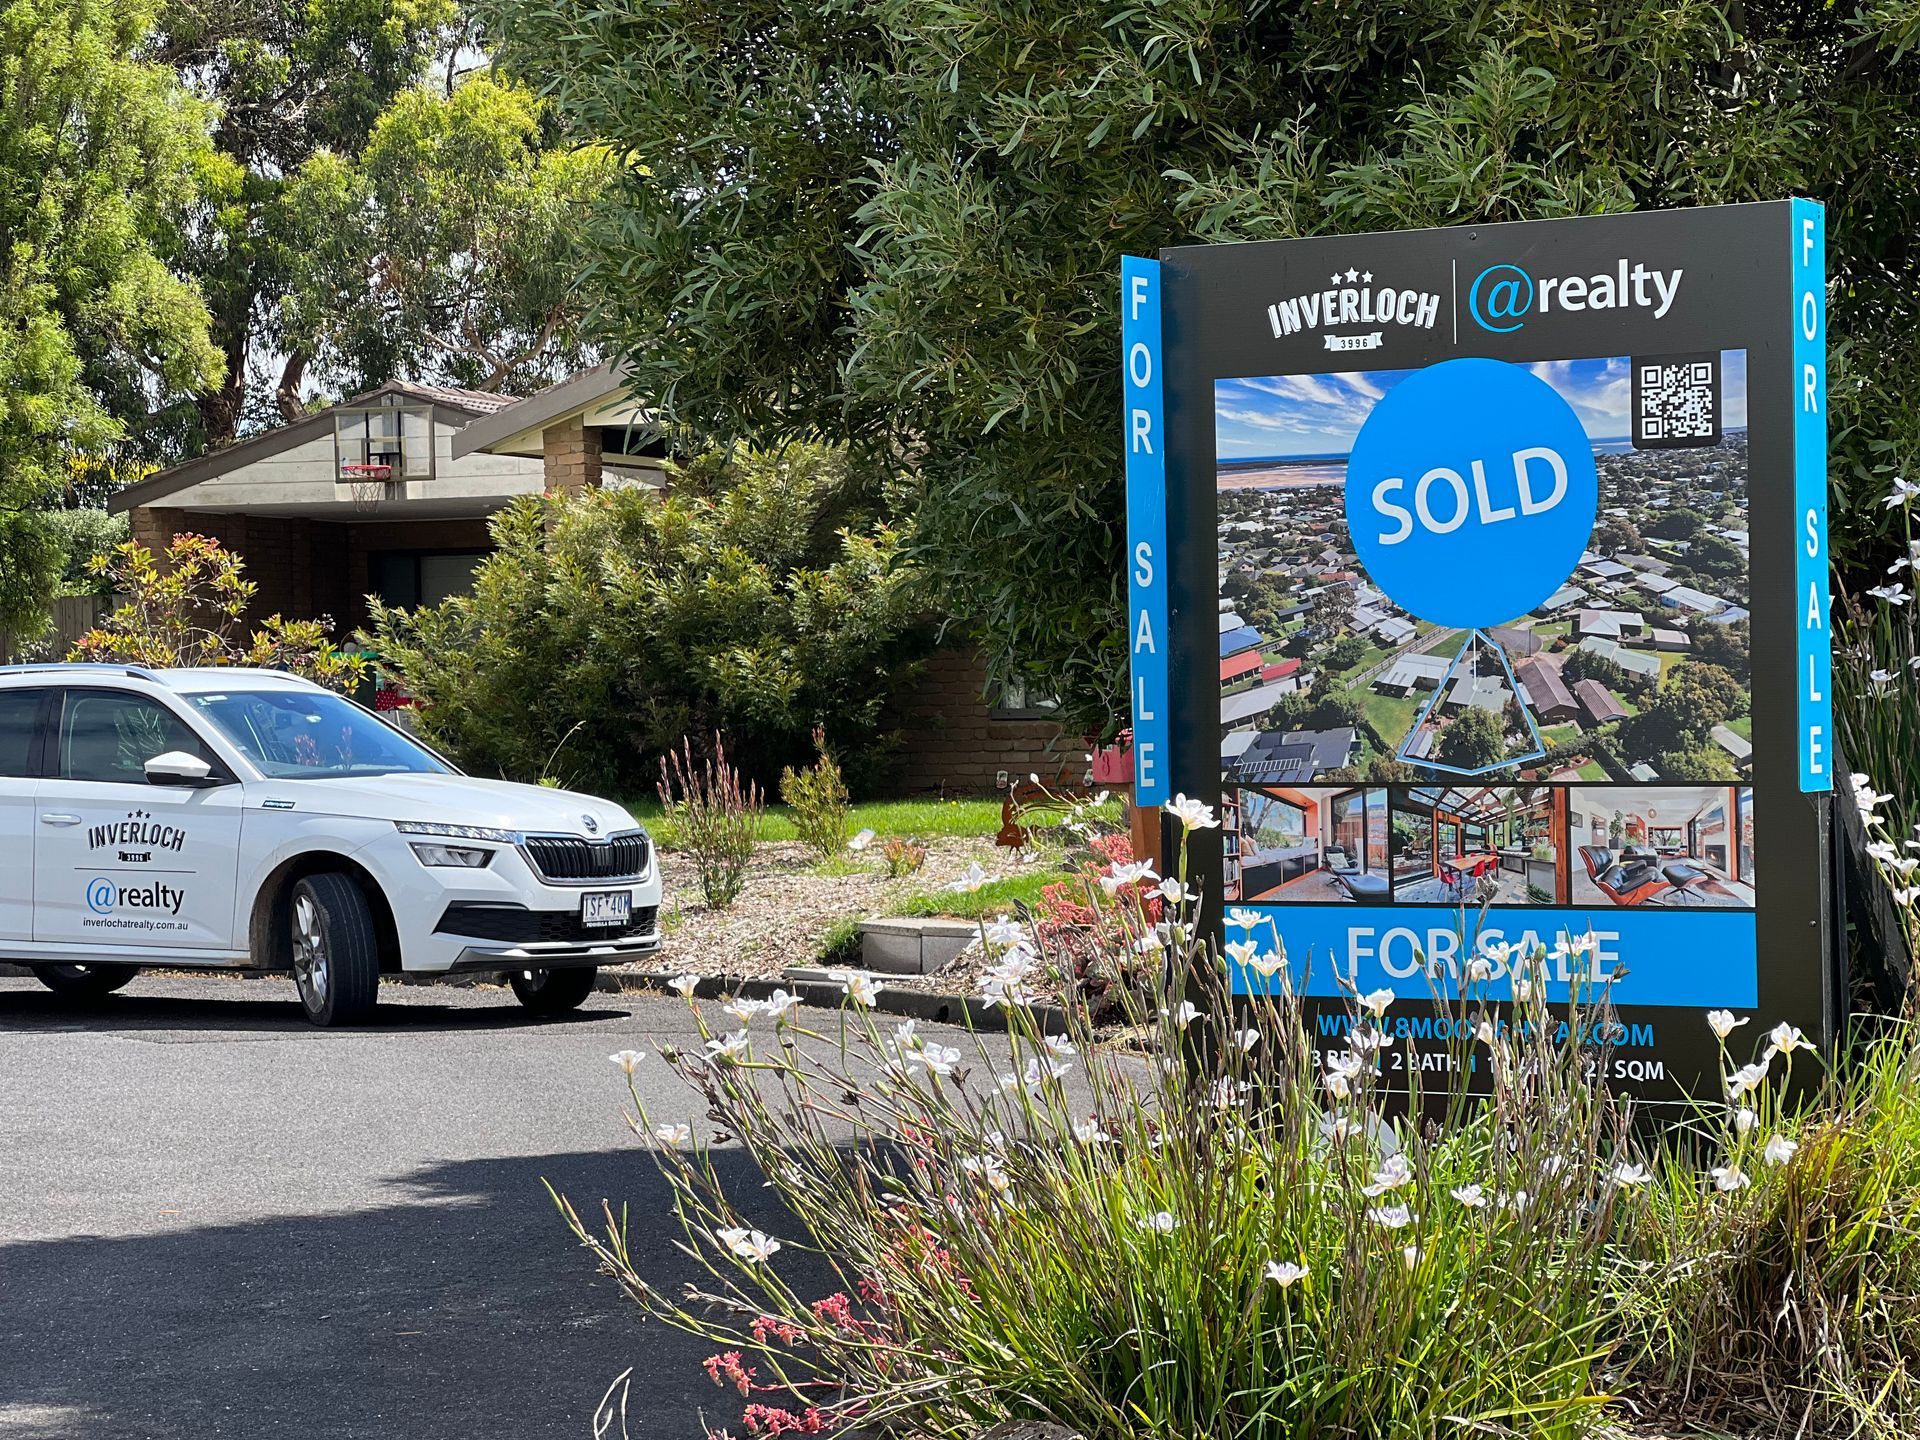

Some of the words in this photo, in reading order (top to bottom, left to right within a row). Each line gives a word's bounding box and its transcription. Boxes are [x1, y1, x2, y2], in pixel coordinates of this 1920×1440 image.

[1267, 287, 1441, 339] INVERLOCH
[1469, 258, 1684, 332] @realty
[1802, 218, 1818, 414] FOR
[1129, 275, 1154, 455] FOR
[1340, 338, 1368, 349] 3996
[1371, 446, 1568, 545] SOLD
[1134, 541, 1156, 788] SALE
[1806, 508, 1822, 774] SALE
[87, 822, 186, 852] INVERLOCH
[83, 917, 189, 931] inverlochatrealty.com.au
[86, 877, 185, 916] @realty
[1347, 927, 1460, 981] FOR
[1475, 928, 1621, 984] SALE
[1391, 1053, 1403, 1070] 2
[1614, 1060, 1665, 1082] SQM
